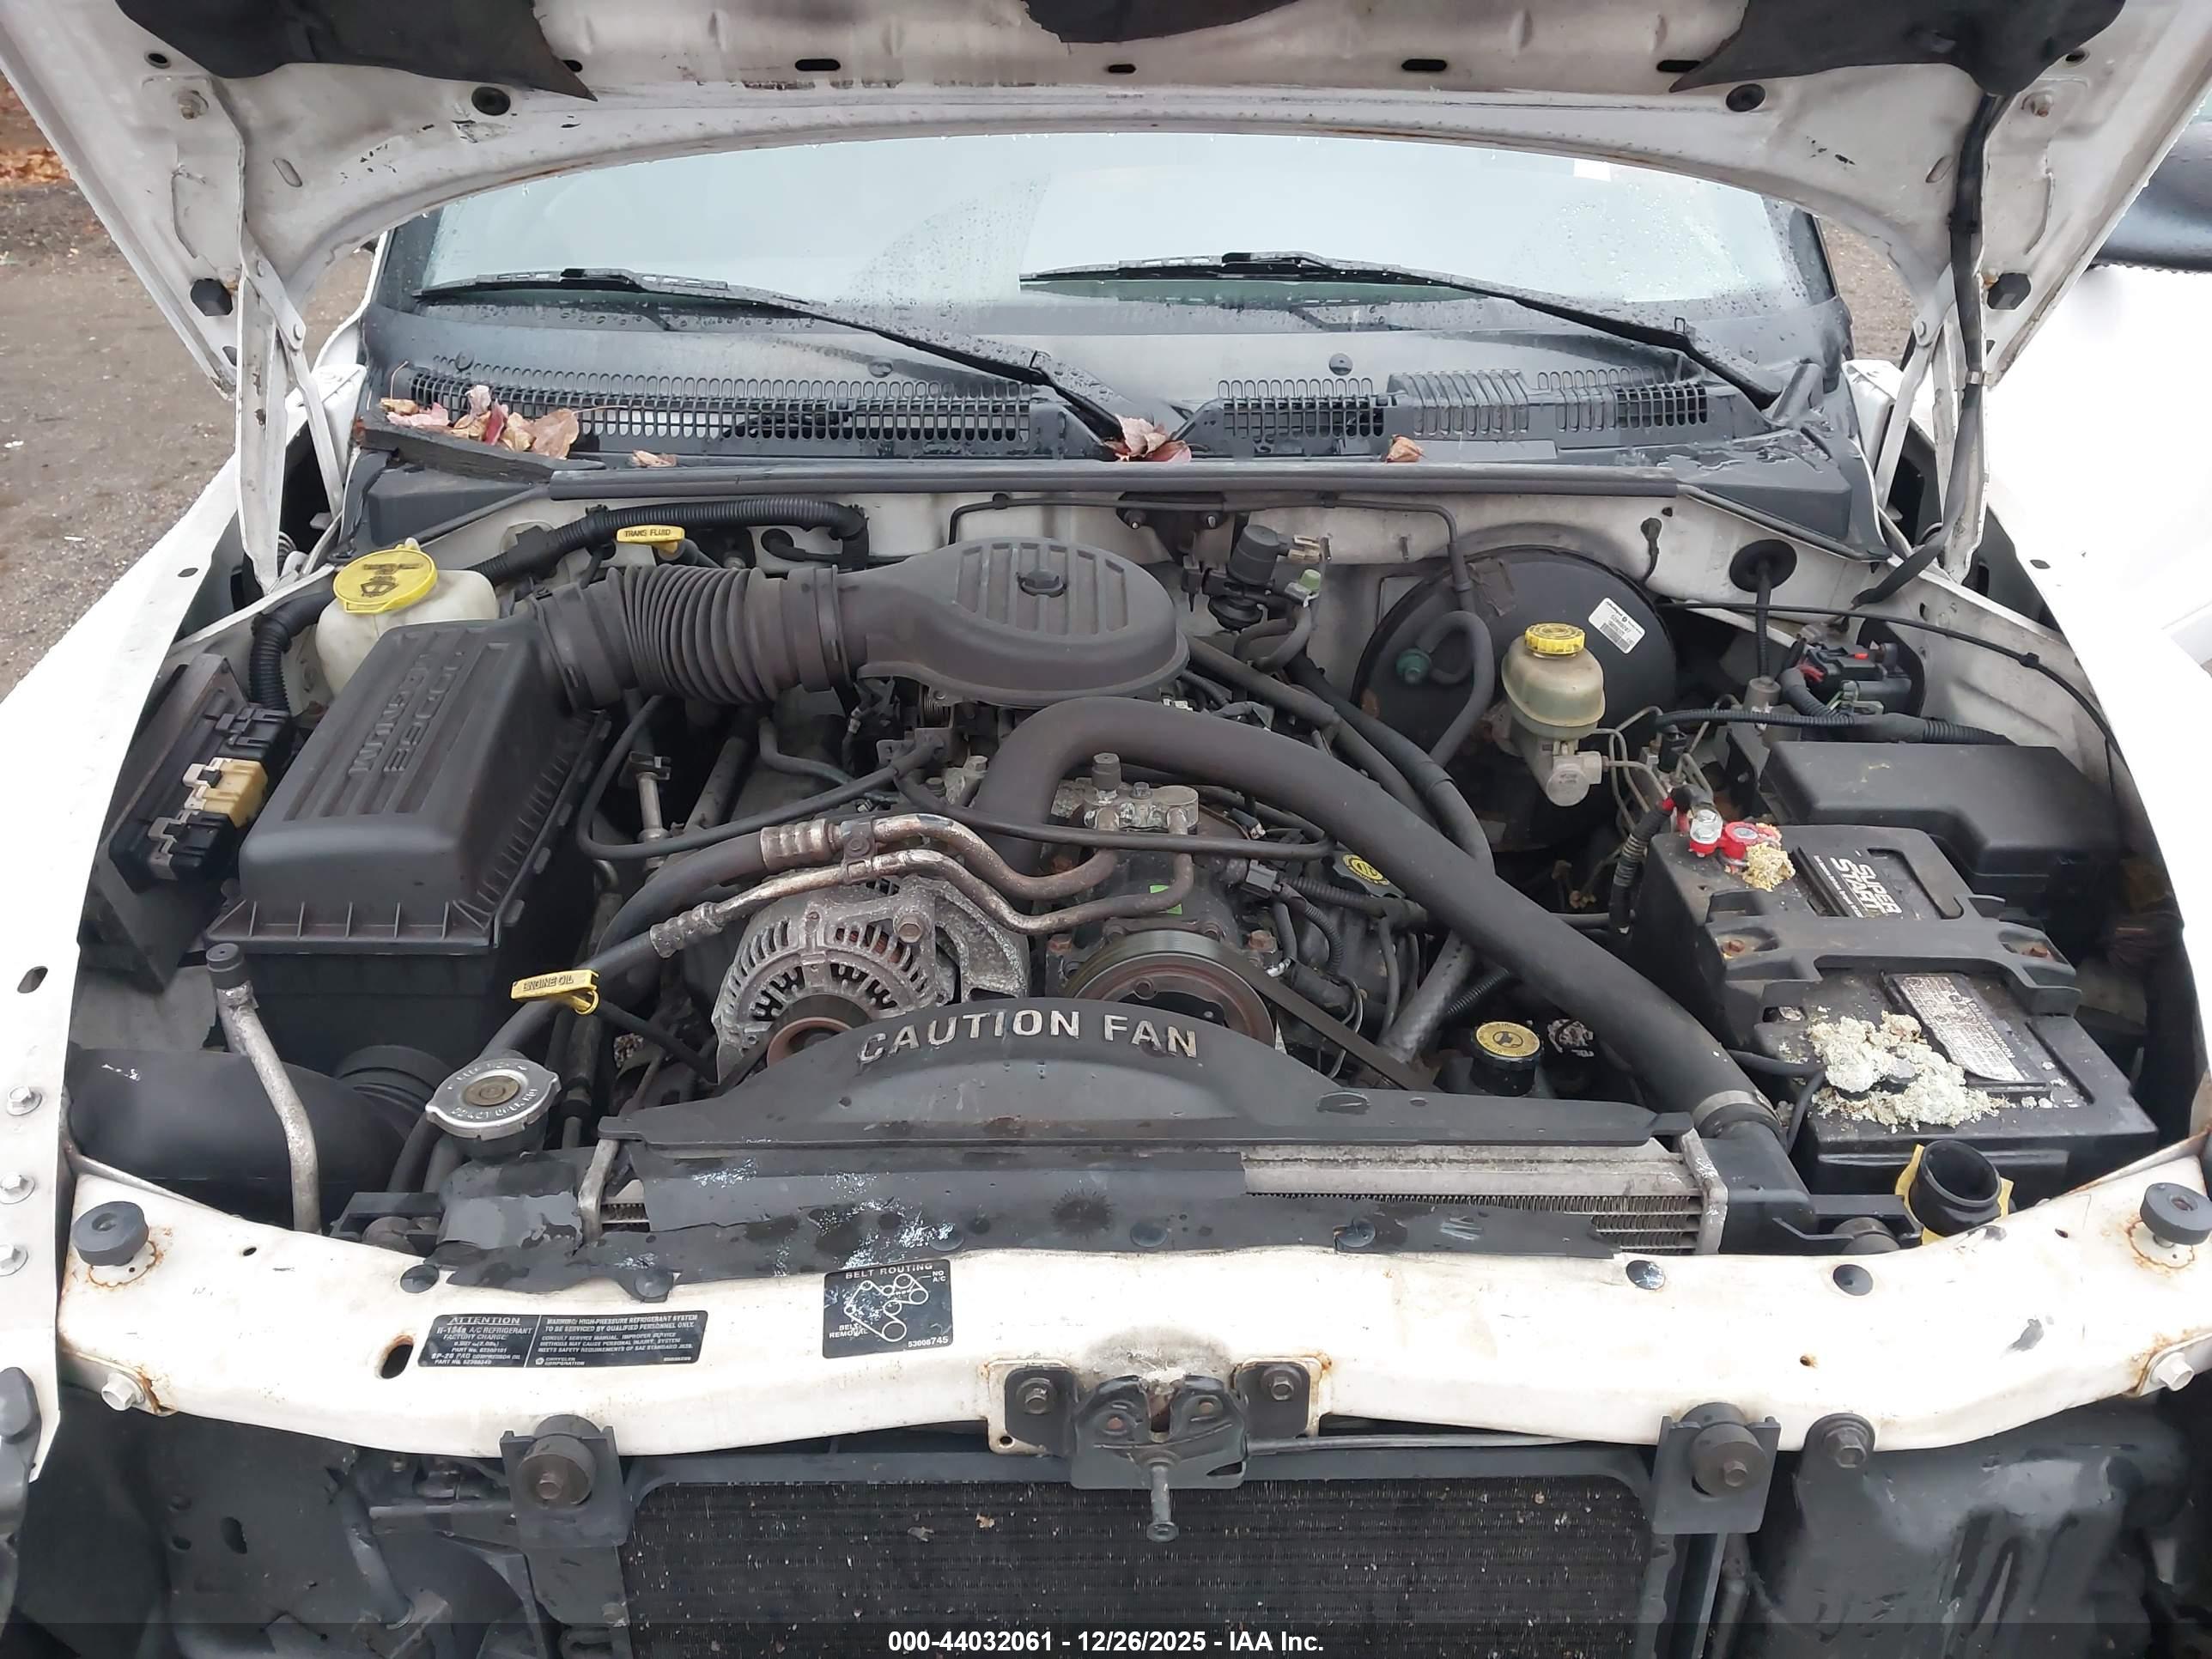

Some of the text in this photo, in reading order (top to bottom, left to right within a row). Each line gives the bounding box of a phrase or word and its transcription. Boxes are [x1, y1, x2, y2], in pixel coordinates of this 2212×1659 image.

[1830, 857, 1887, 915] START
[1856, 863, 1903, 915] SUPER
[523, 975, 574, 991] ENGINE OIL
[858, 1009, 1198, 1064] CAUTION FAN
[845, 1263, 933, 1279] BELT ROUTING
[908, 1335, 949, 1347] 53008745
